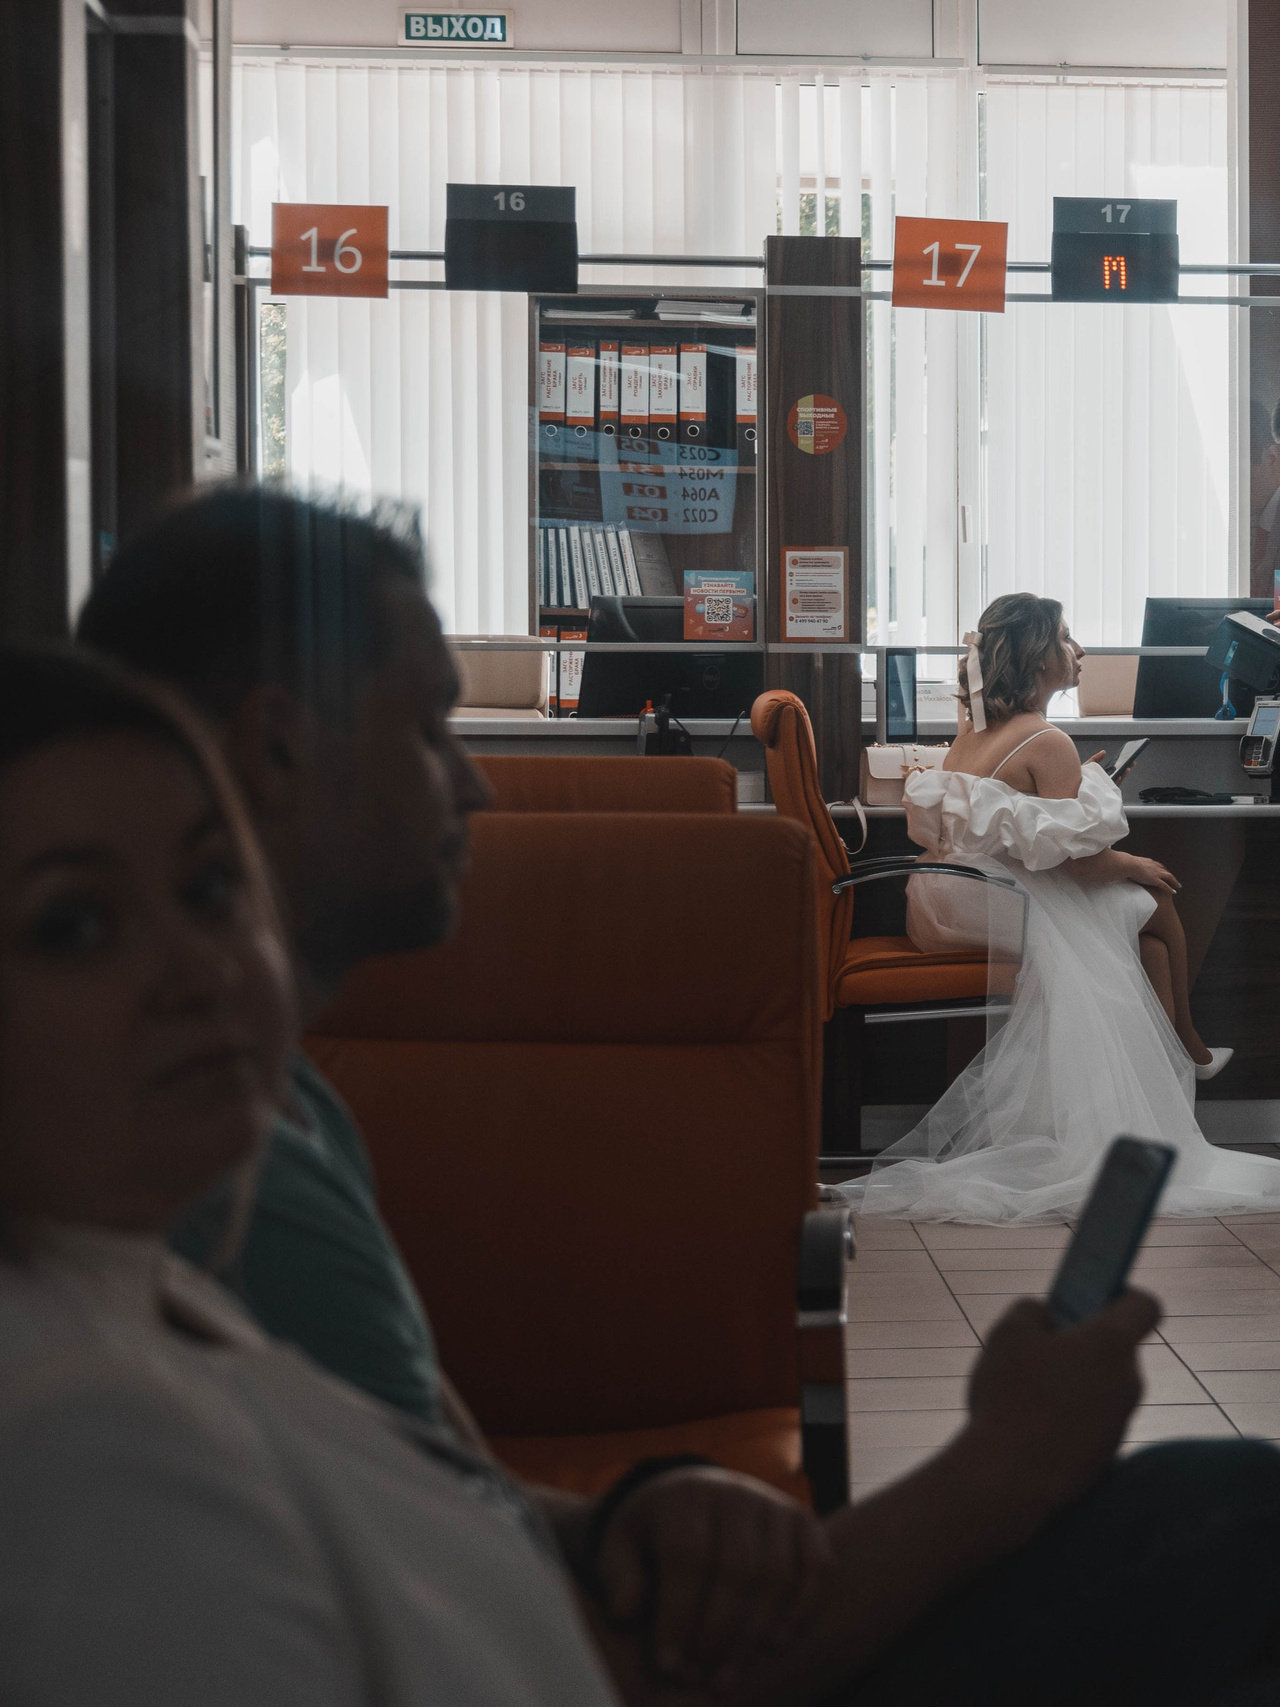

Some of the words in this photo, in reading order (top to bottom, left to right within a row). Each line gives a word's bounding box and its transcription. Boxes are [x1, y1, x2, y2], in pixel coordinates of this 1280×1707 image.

[410, 16, 503, 41] ВЫХОД
[493, 191, 526, 212] 16
[1101, 204, 1131, 223] 17
[300, 226, 363, 274] 16
[922, 241, 982, 288] 17
